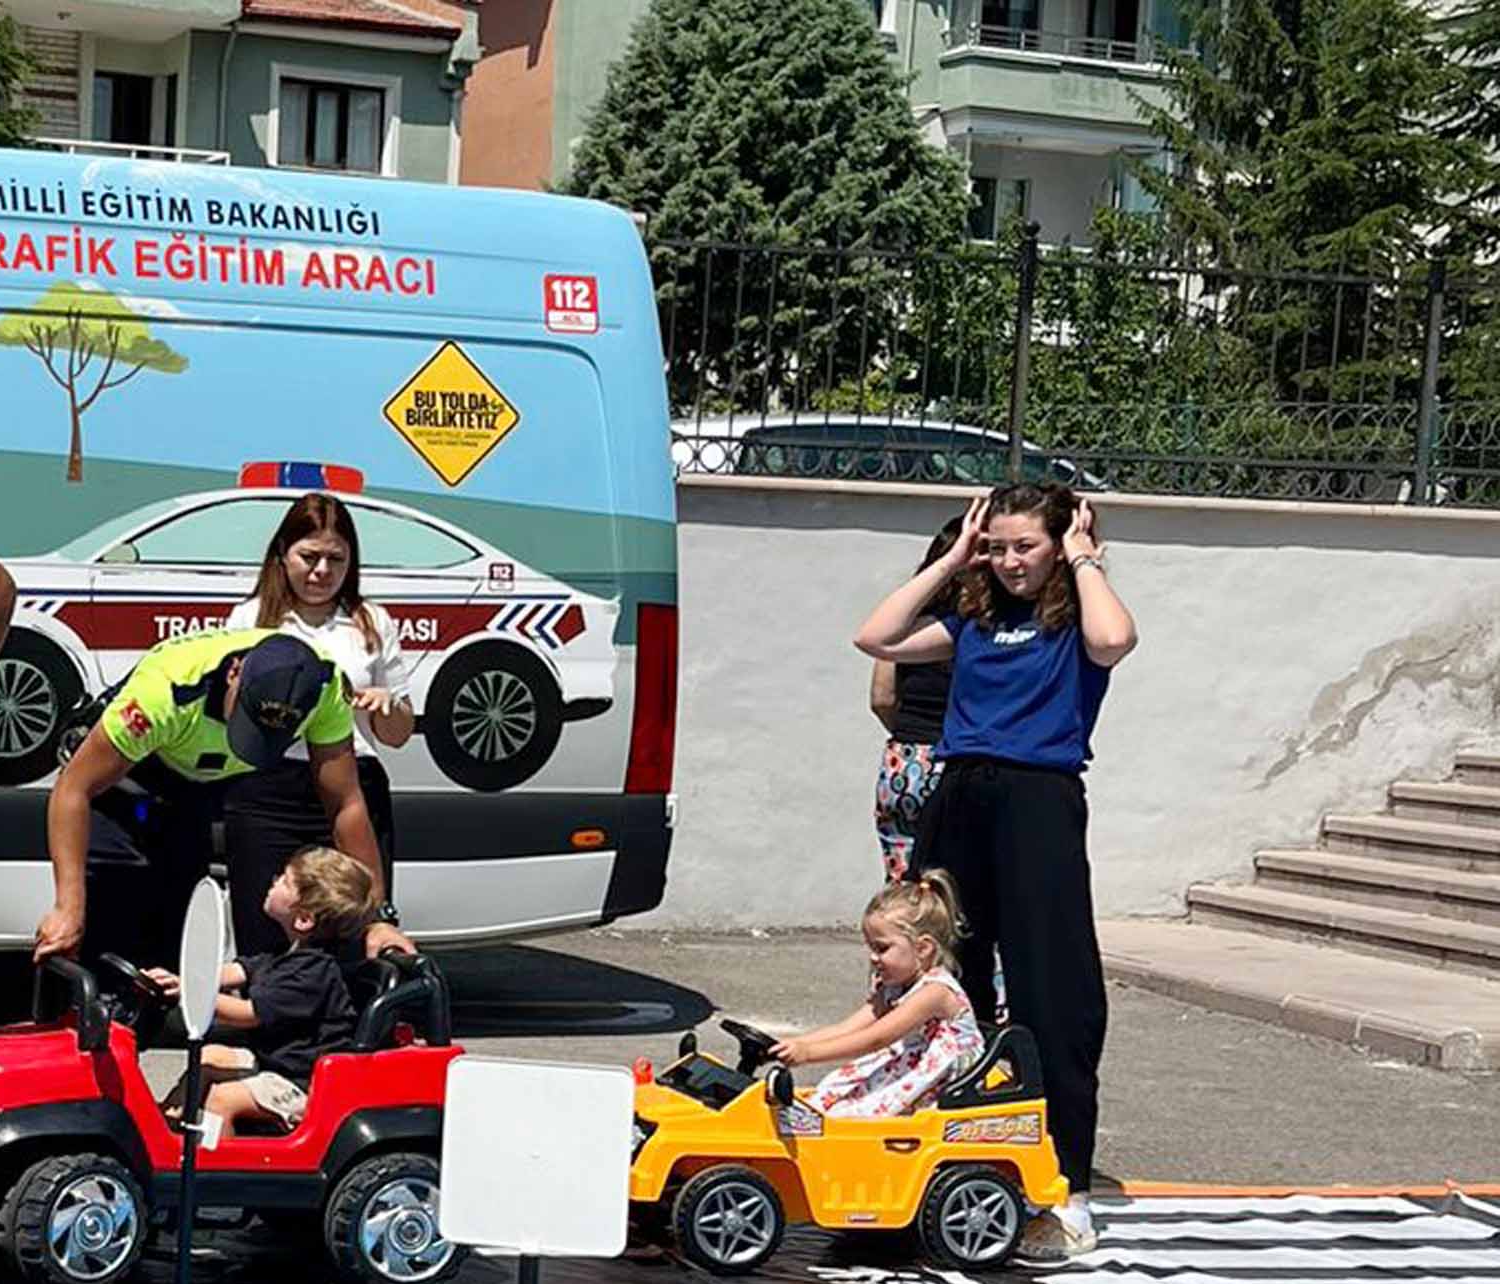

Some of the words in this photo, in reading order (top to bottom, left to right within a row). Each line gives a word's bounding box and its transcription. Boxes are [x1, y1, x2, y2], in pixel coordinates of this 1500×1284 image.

[81, 184, 194, 224] EĞİTİM
[205, 199, 381, 236] BAKANLIĞI
[133, 231, 285, 287] EĞİTİM
[300, 250, 436, 296] ARACI
[550, 279, 592, 309] 112
[413, 389, 436, 408] BU
[437, 391, 490, 412] YOLDA
[404, 408, 499, 431] BİRLİKTEYİZ
